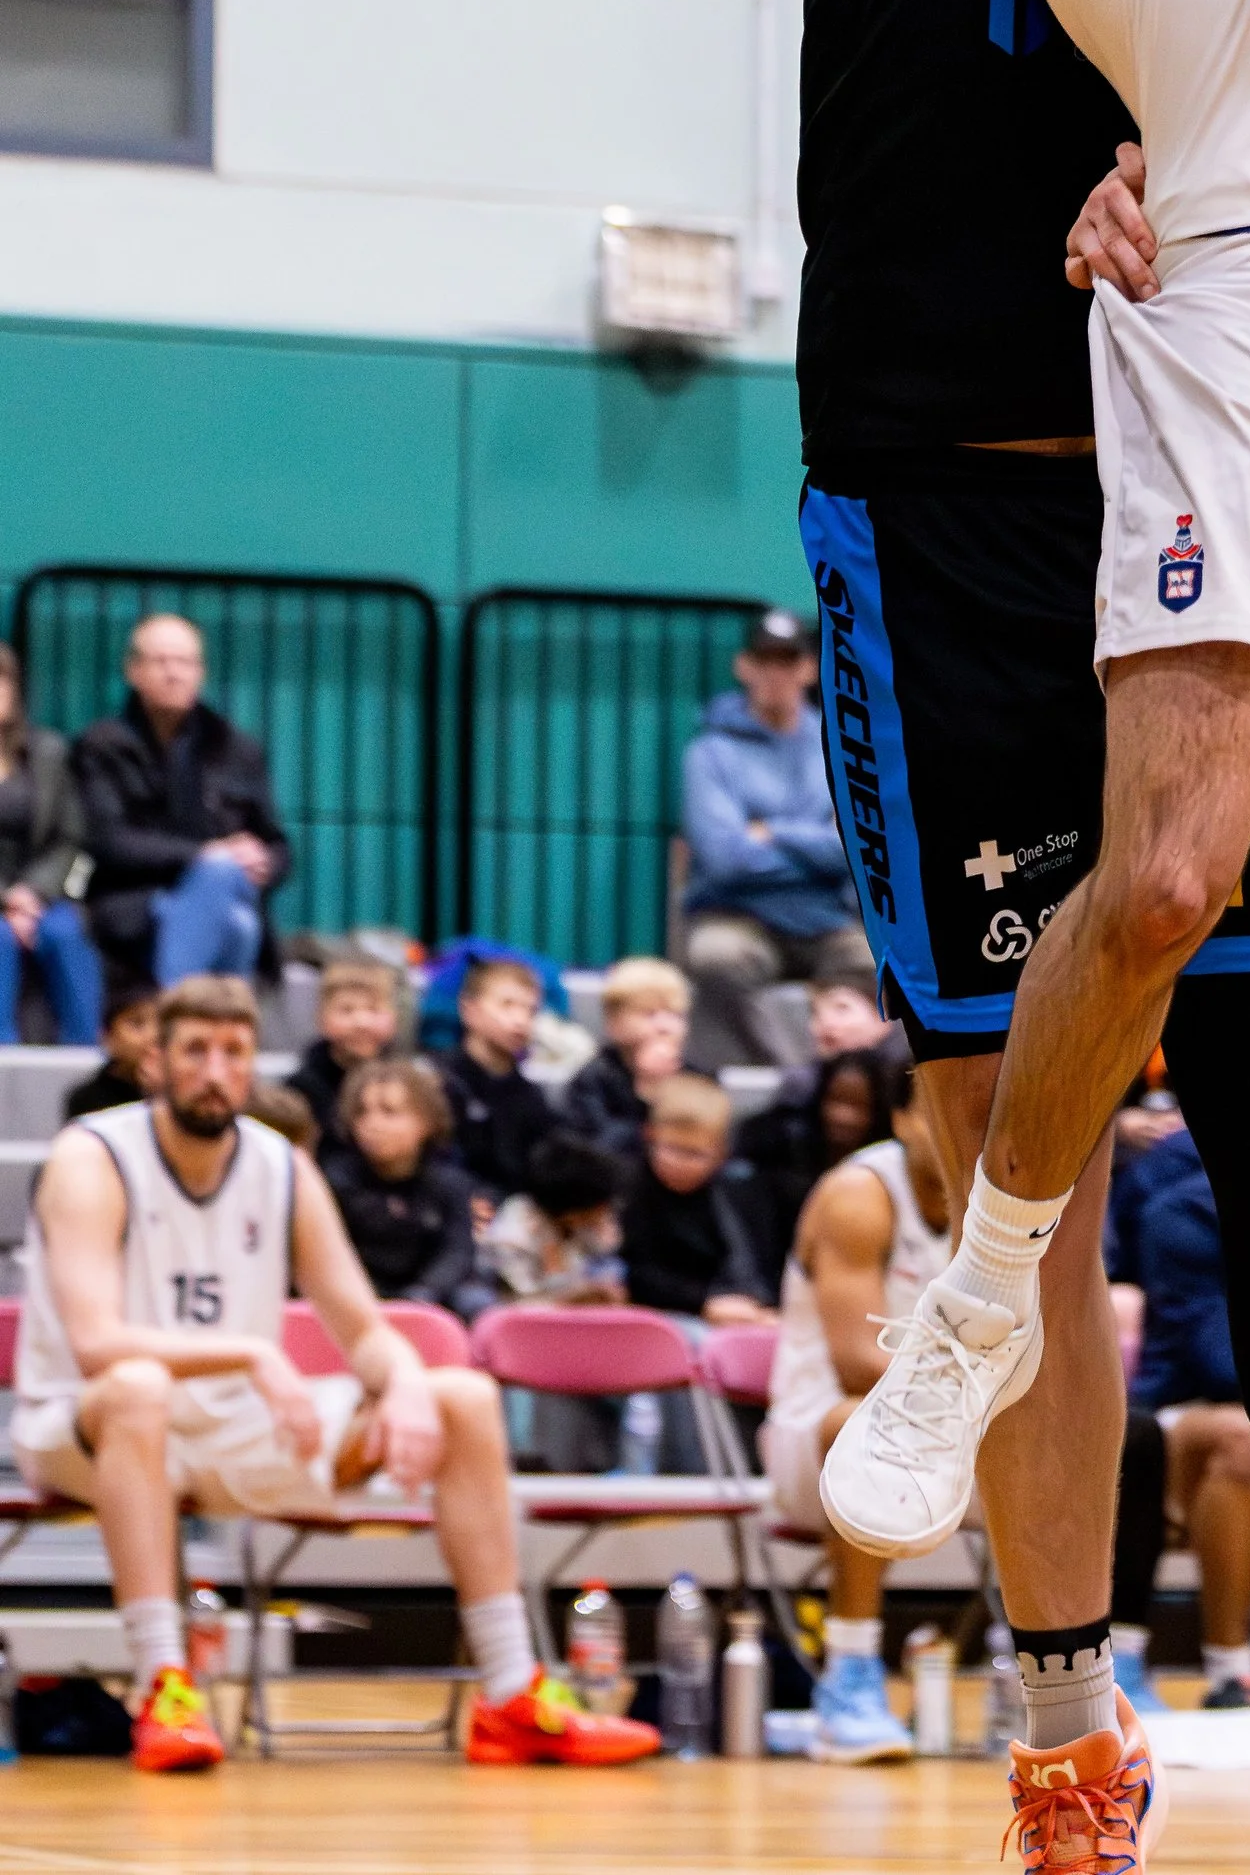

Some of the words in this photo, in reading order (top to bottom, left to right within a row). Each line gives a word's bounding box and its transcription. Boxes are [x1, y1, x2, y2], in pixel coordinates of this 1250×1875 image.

[814, 559, 897, 925] SKECHERS
[1016, 844, 1044, 866] One
[1046, 830, 1079, 853] Stop
[169, 1272, 223, 1325] 15
